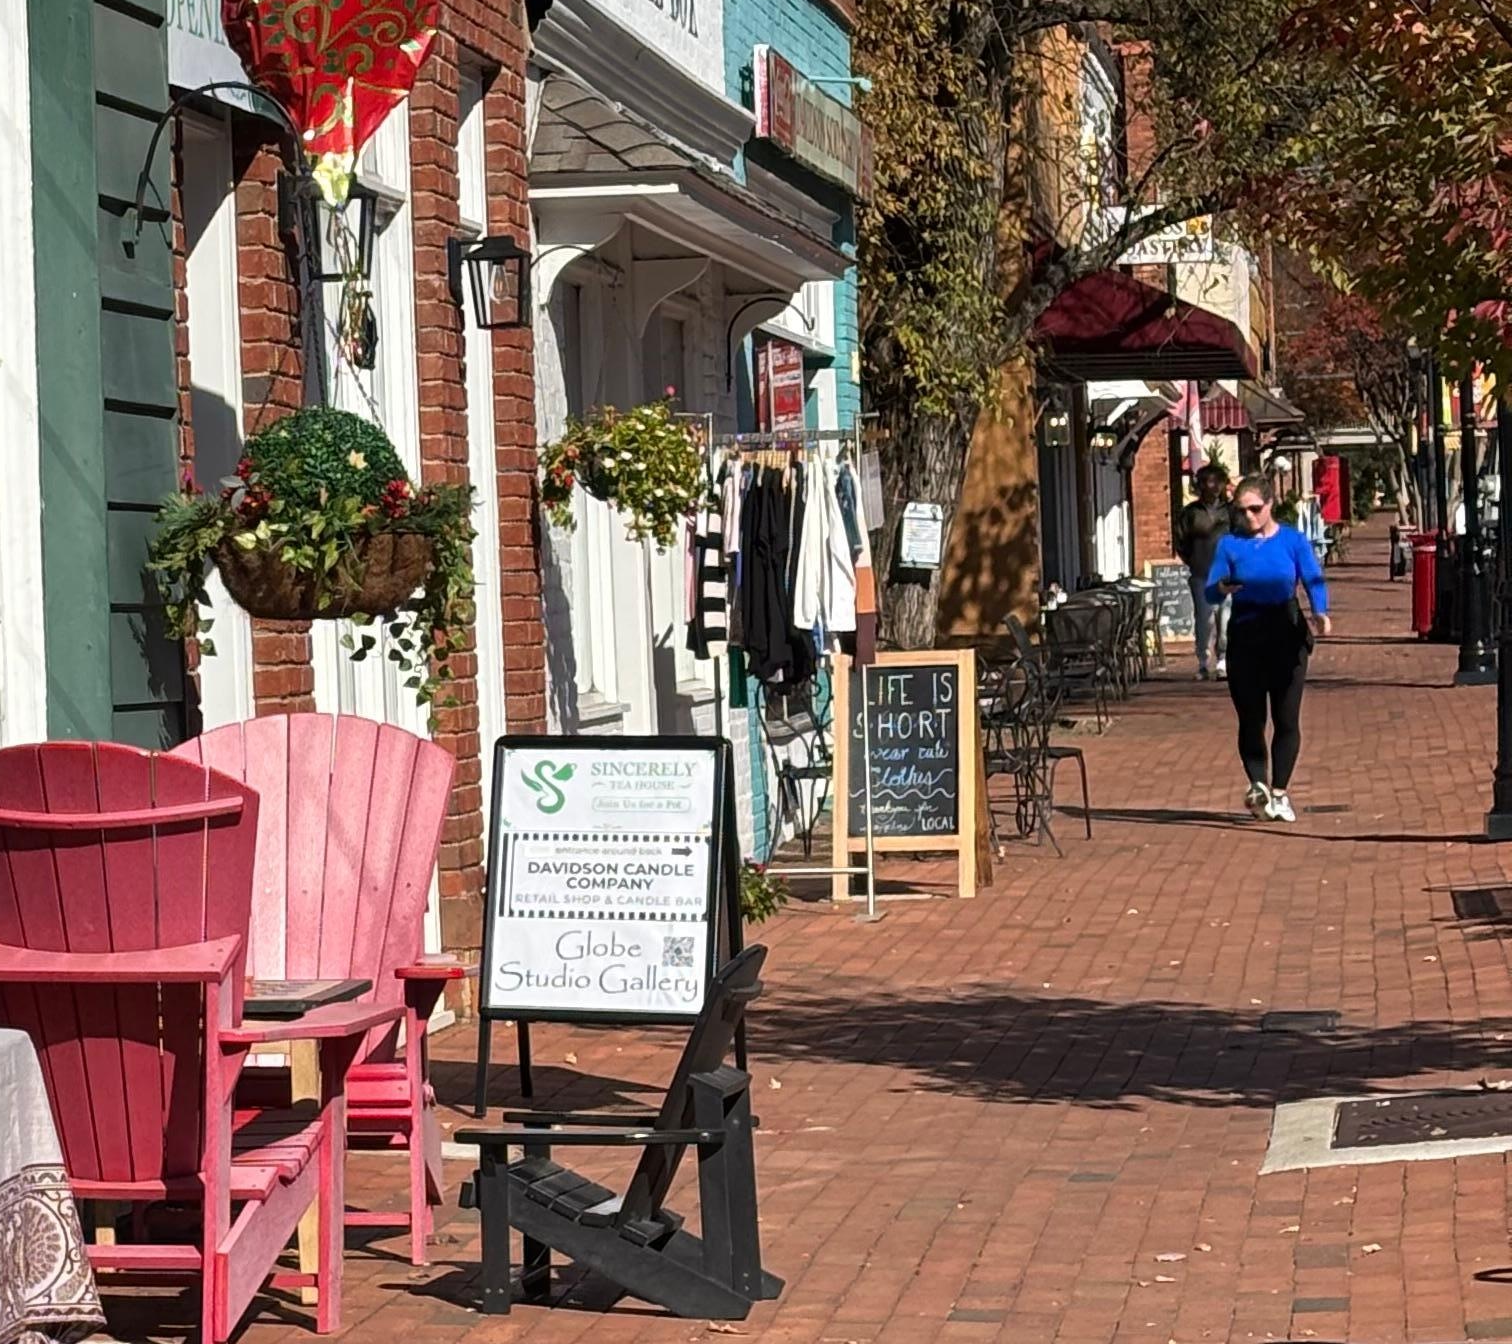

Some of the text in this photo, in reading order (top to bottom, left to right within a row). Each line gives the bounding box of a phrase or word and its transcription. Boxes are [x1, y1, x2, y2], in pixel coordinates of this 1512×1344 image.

[932, 672, 953, 706] IS
[590, 761, 696, 777] SINCERELY
[609, 780, 675, 791] TEA HOUSE
[921, 816, 955, 831] LOCAL
[528, 861, 695, 877] DAVIDSON CANDLE
[566, 877, 654, 890] COMPANY
[515, 893, 703, 907] RETAIL SHOP & CANDLE BAR
[555, 930, 642, 960] Globe
[495, 961, 698, 1002] Studio Gallery
